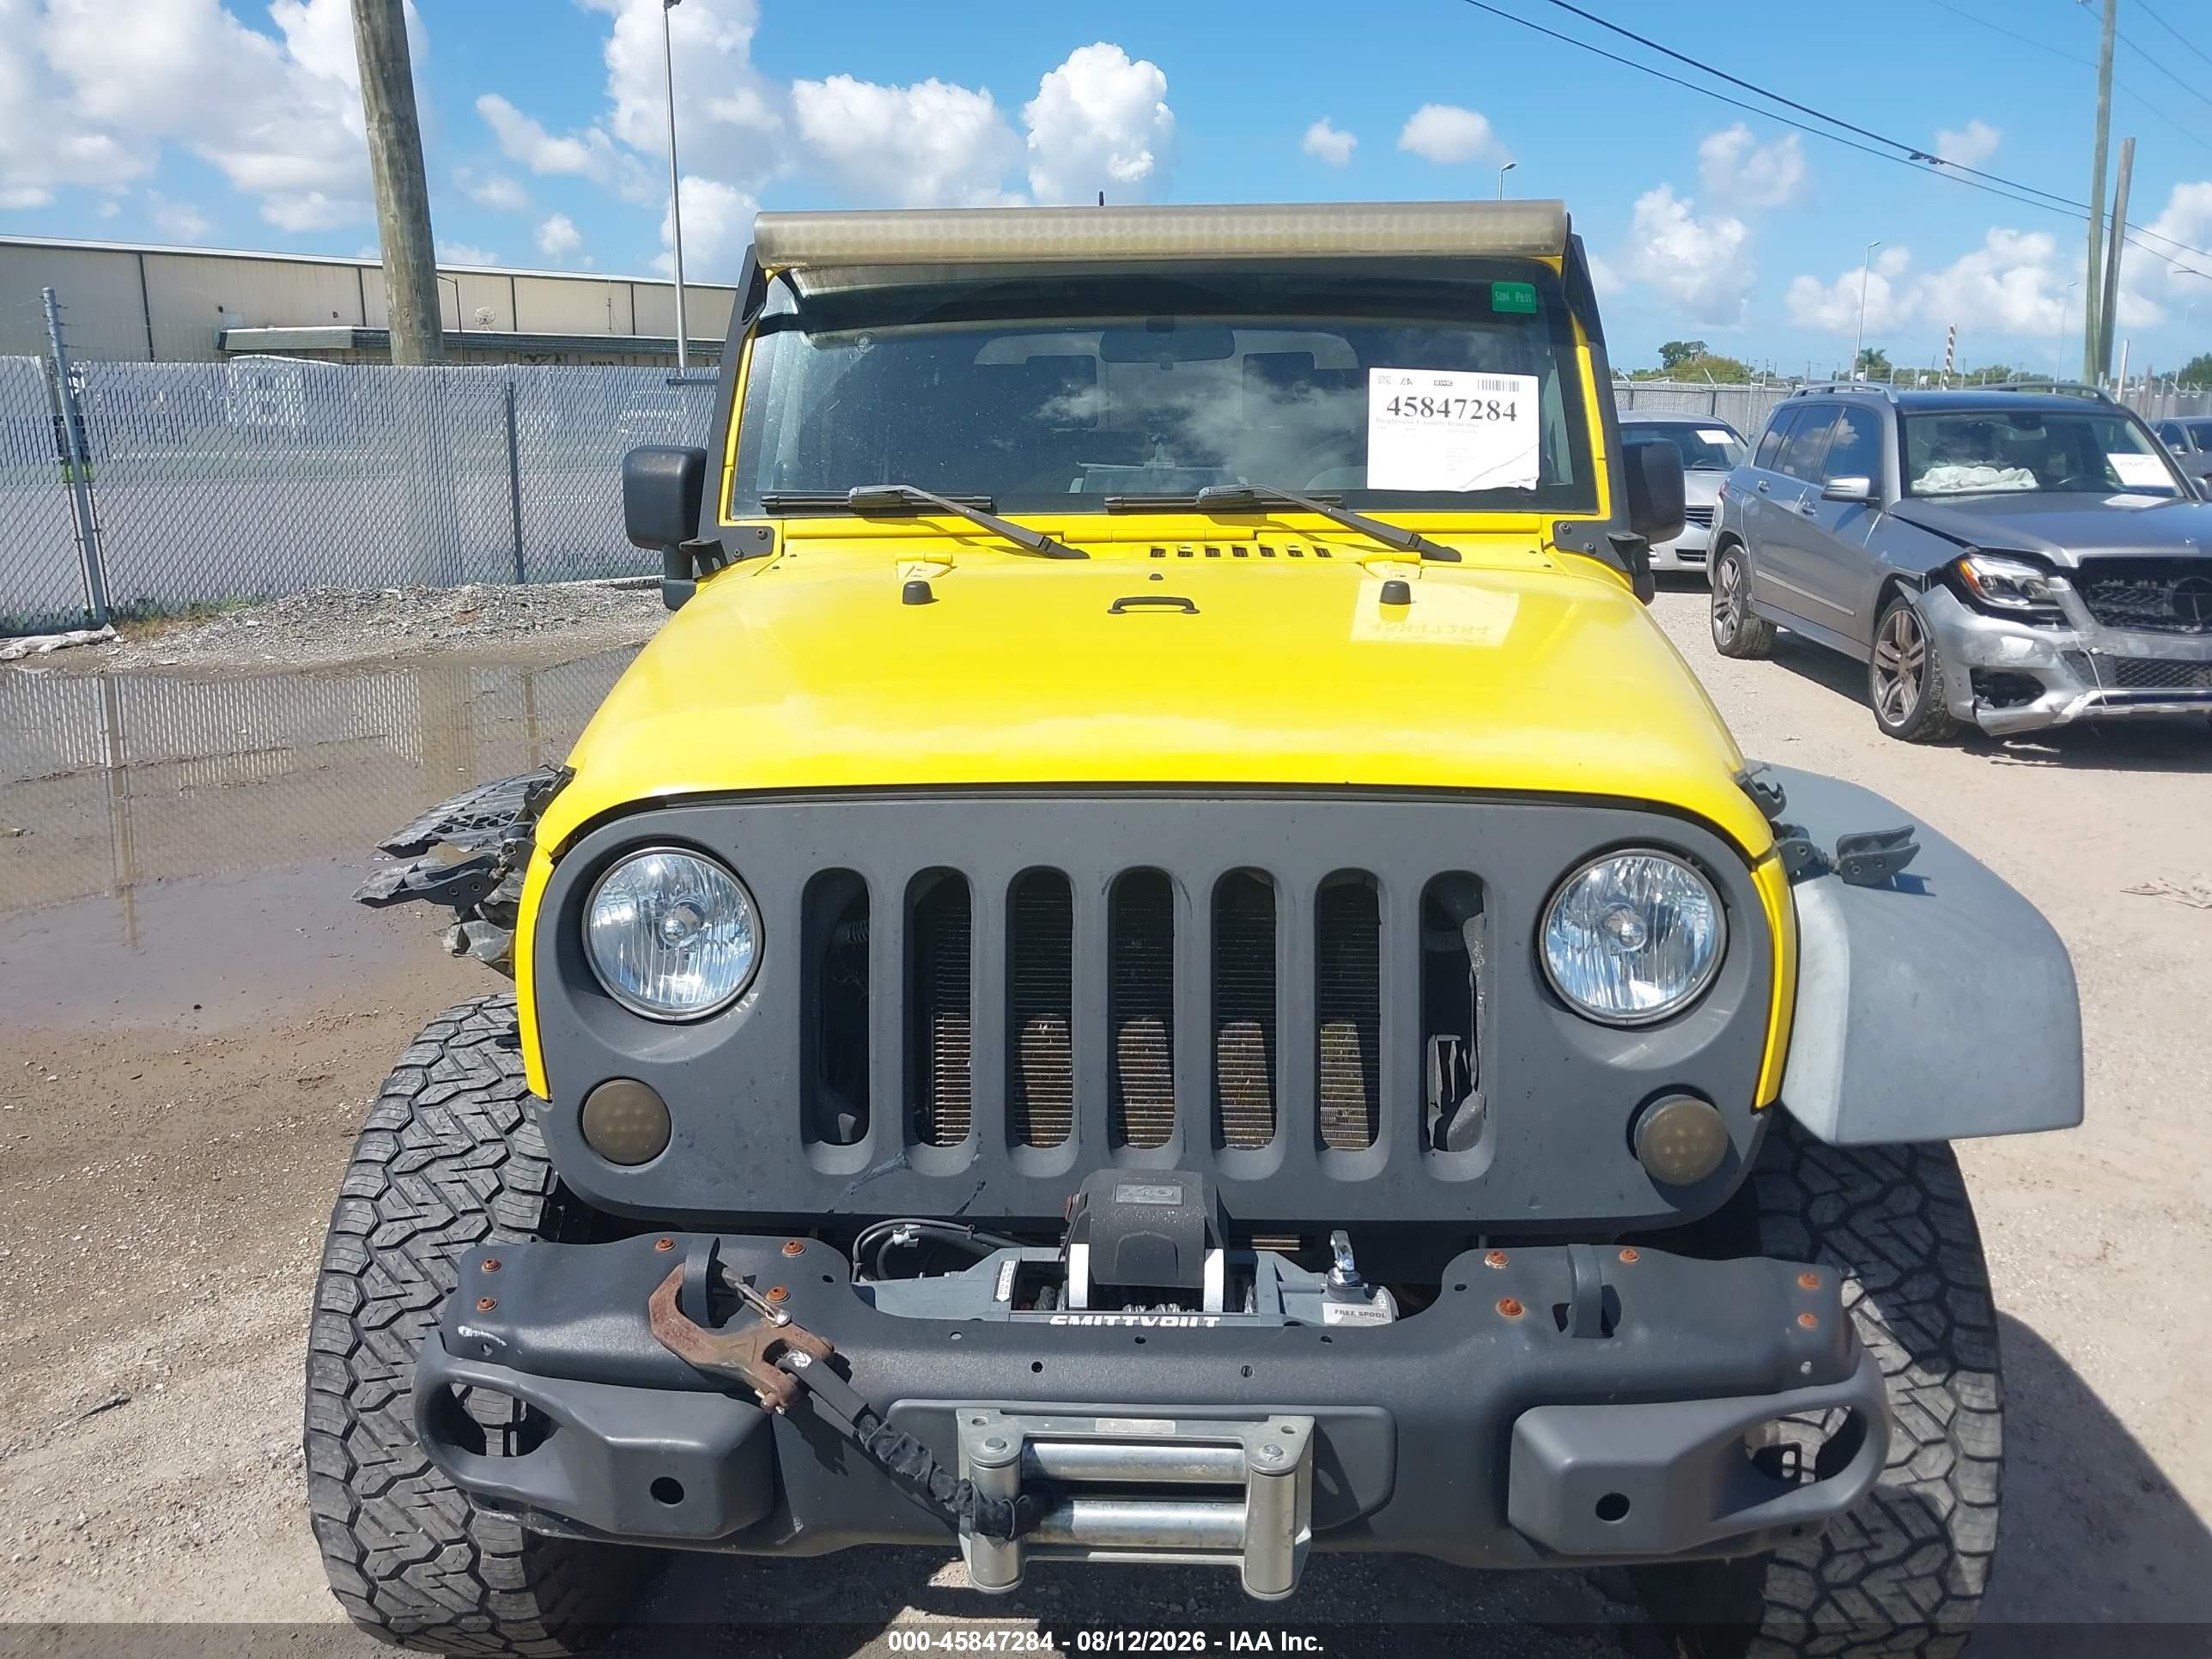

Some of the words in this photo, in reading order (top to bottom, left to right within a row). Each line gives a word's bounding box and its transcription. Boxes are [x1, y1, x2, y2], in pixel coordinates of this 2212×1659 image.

[1516, 291, 1532, 303] PASS
[1387, 395, 1517, 422] 45847284
[1358, 1310, 1388, 1319] SPOOL
